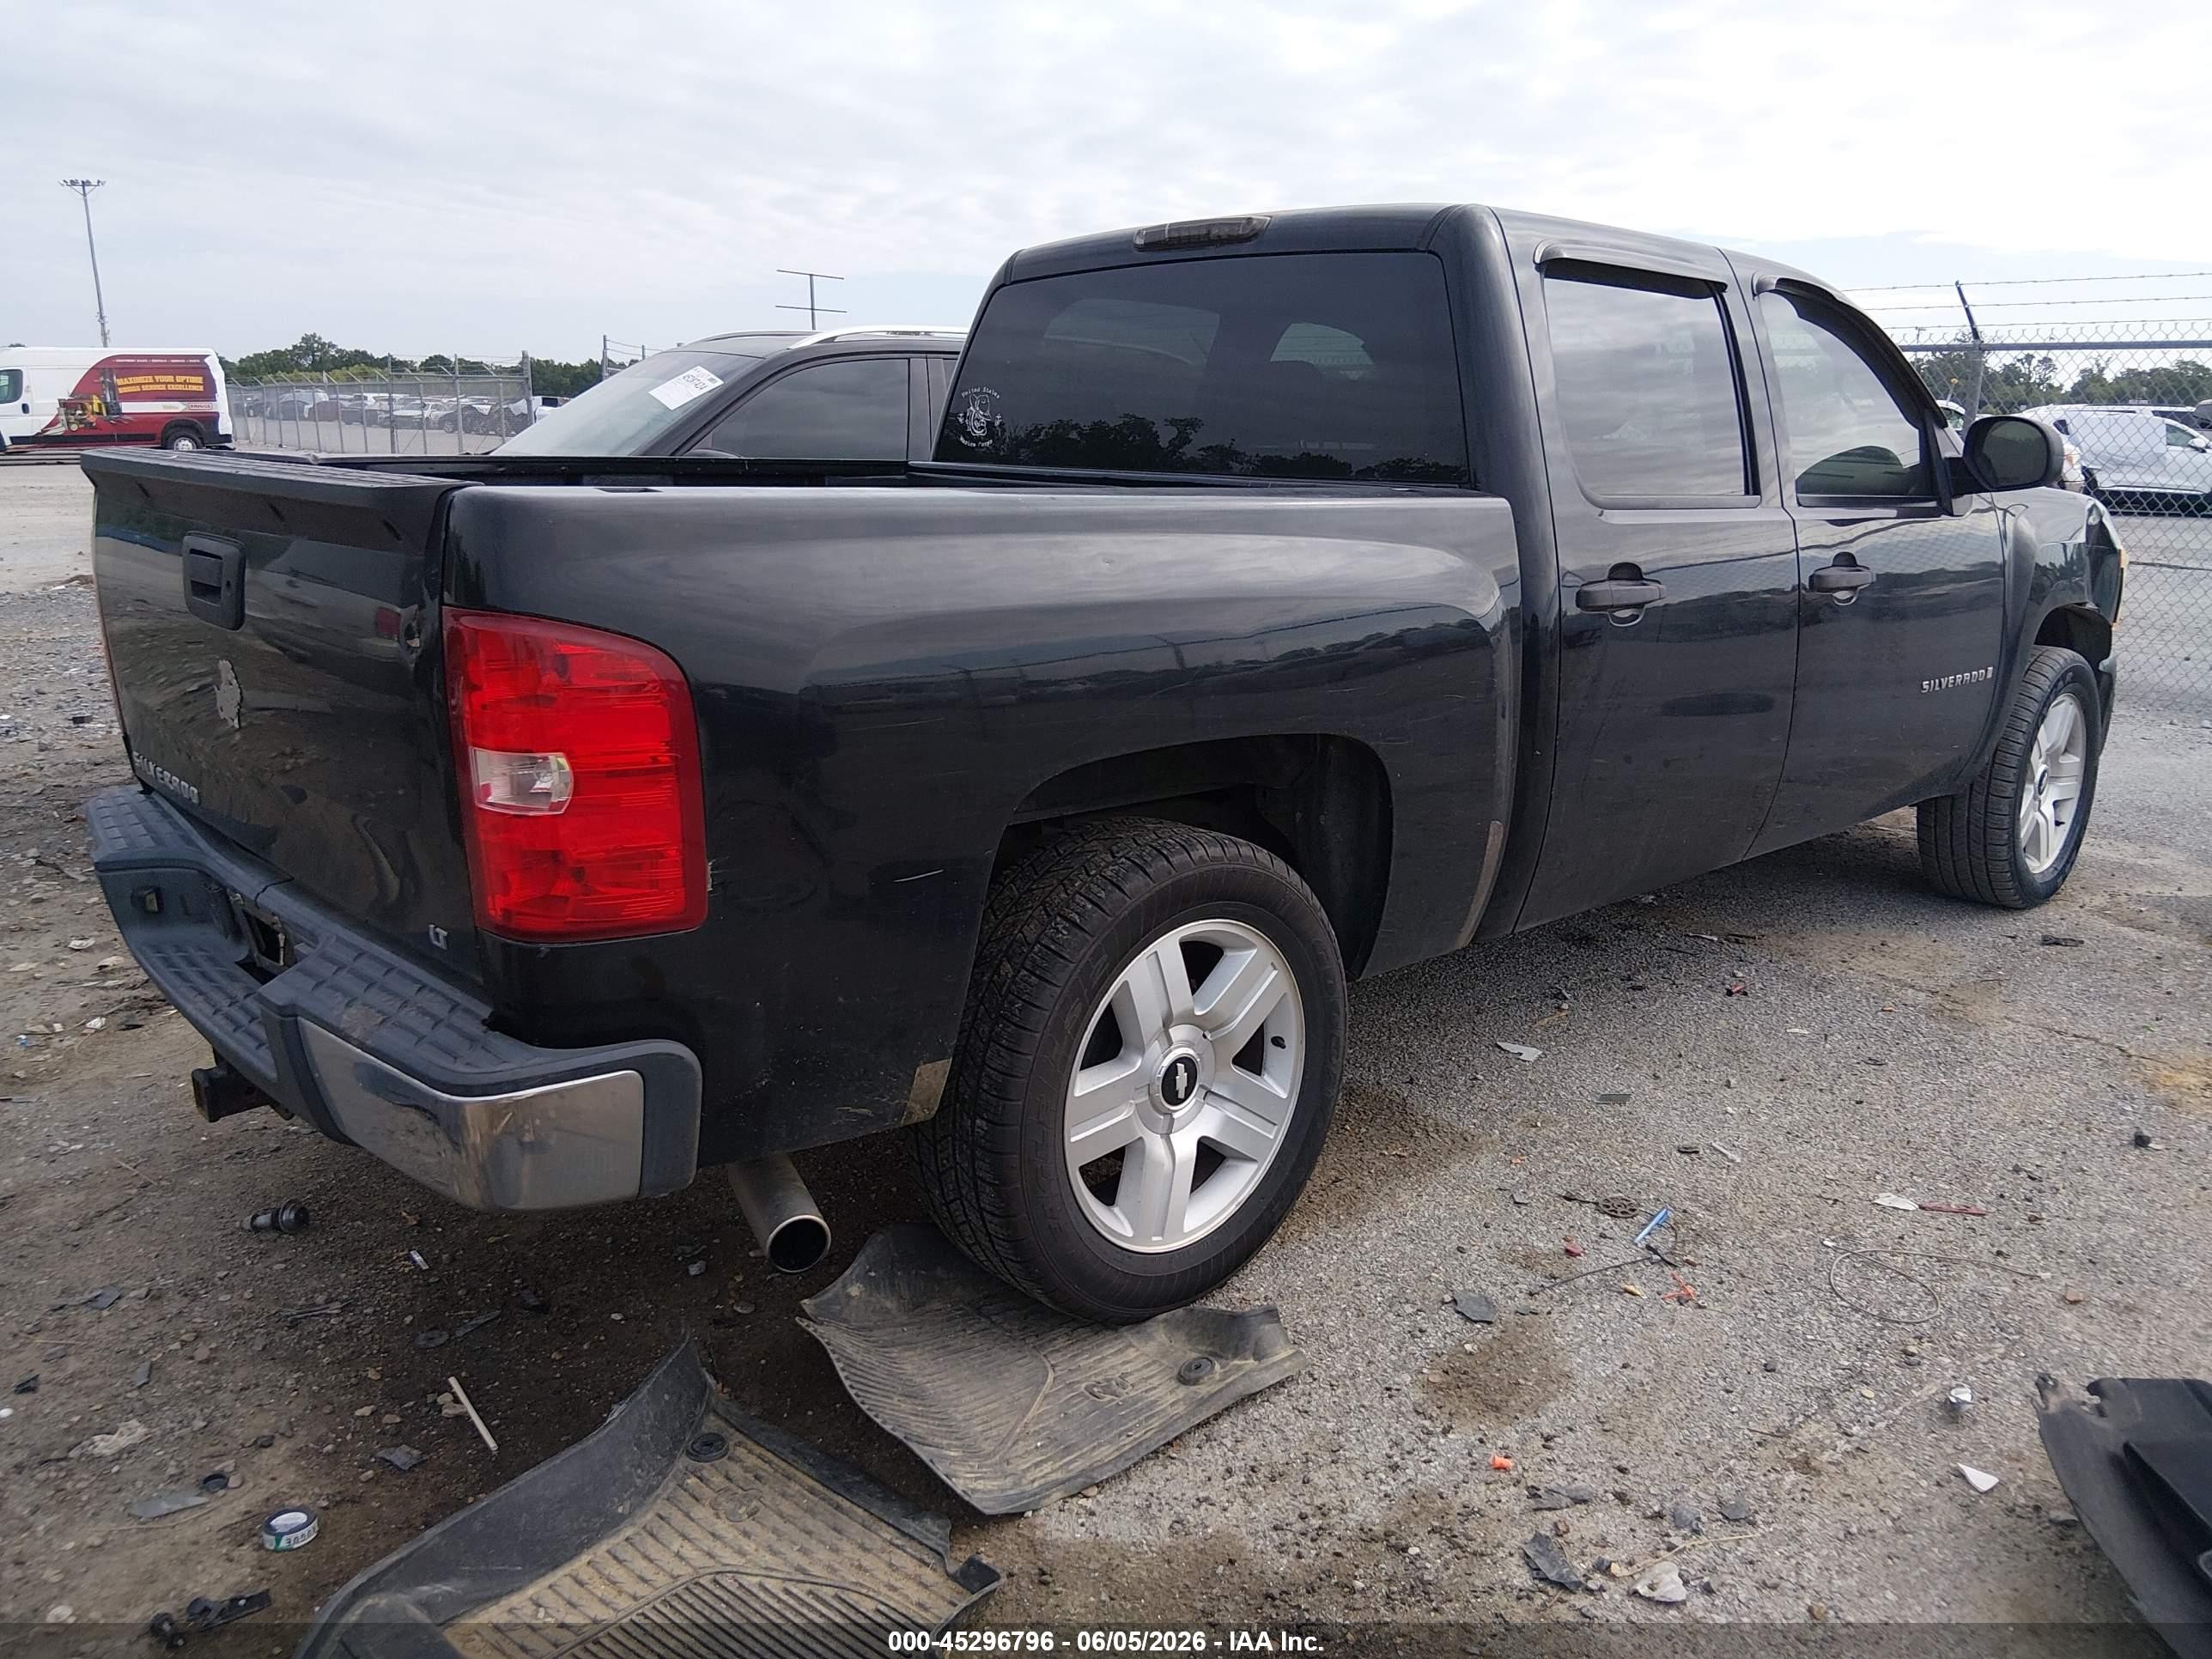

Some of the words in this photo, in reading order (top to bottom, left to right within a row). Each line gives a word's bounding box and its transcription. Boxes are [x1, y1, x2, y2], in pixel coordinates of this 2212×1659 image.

[117, 375, 153, 386] MAXIMIZE
[175, 375, 204, 385] UPTIME
[982, 386, 1000, 399] States
[1921, 669, 1986, 694] SILVERADO
[132, 750, 199, 805] SILVERADO
[428, 923, 448, 951] LT
